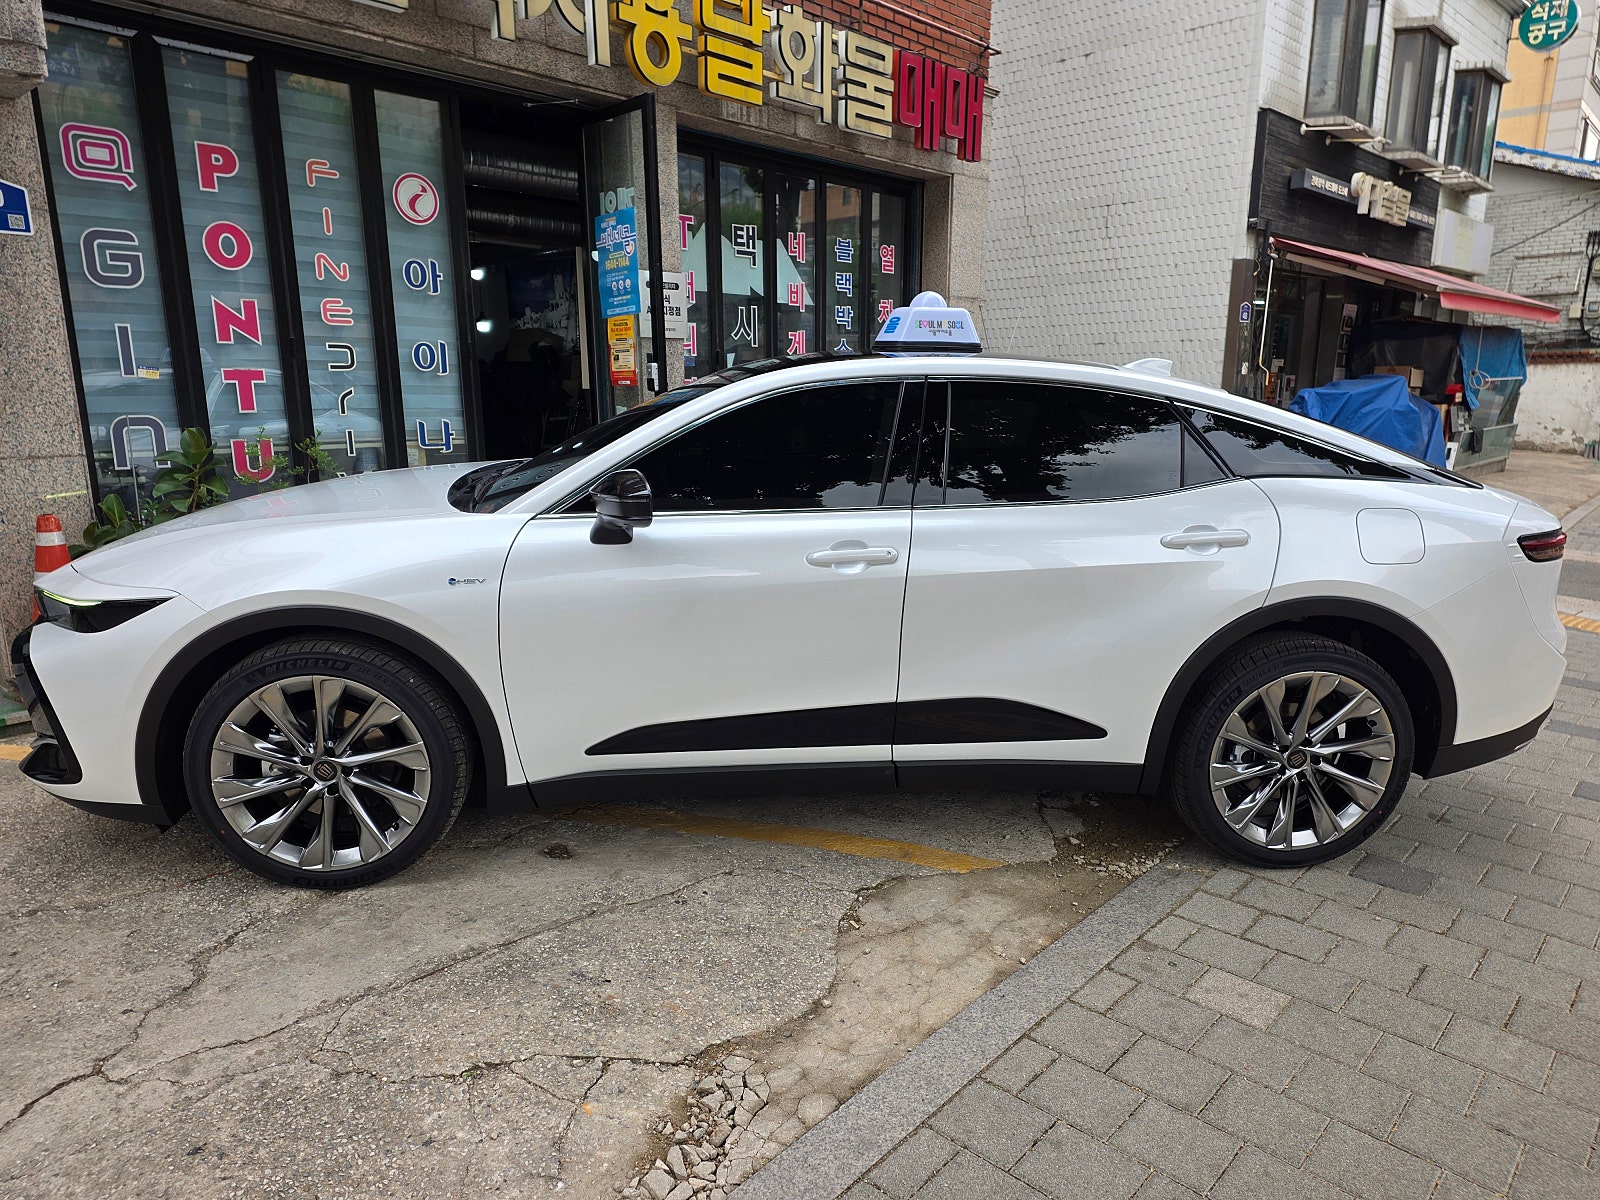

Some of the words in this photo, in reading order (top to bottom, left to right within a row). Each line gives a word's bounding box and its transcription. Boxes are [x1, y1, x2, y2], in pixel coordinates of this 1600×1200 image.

[1531, 0, 1570, 20] 석재
[1527, 20, 1567, 45] 공구
[914, 319, 936, 330] SEOUL
[947, 320, 965, 330] SOUL
[265, 659, 346, 675] MICHELIN
